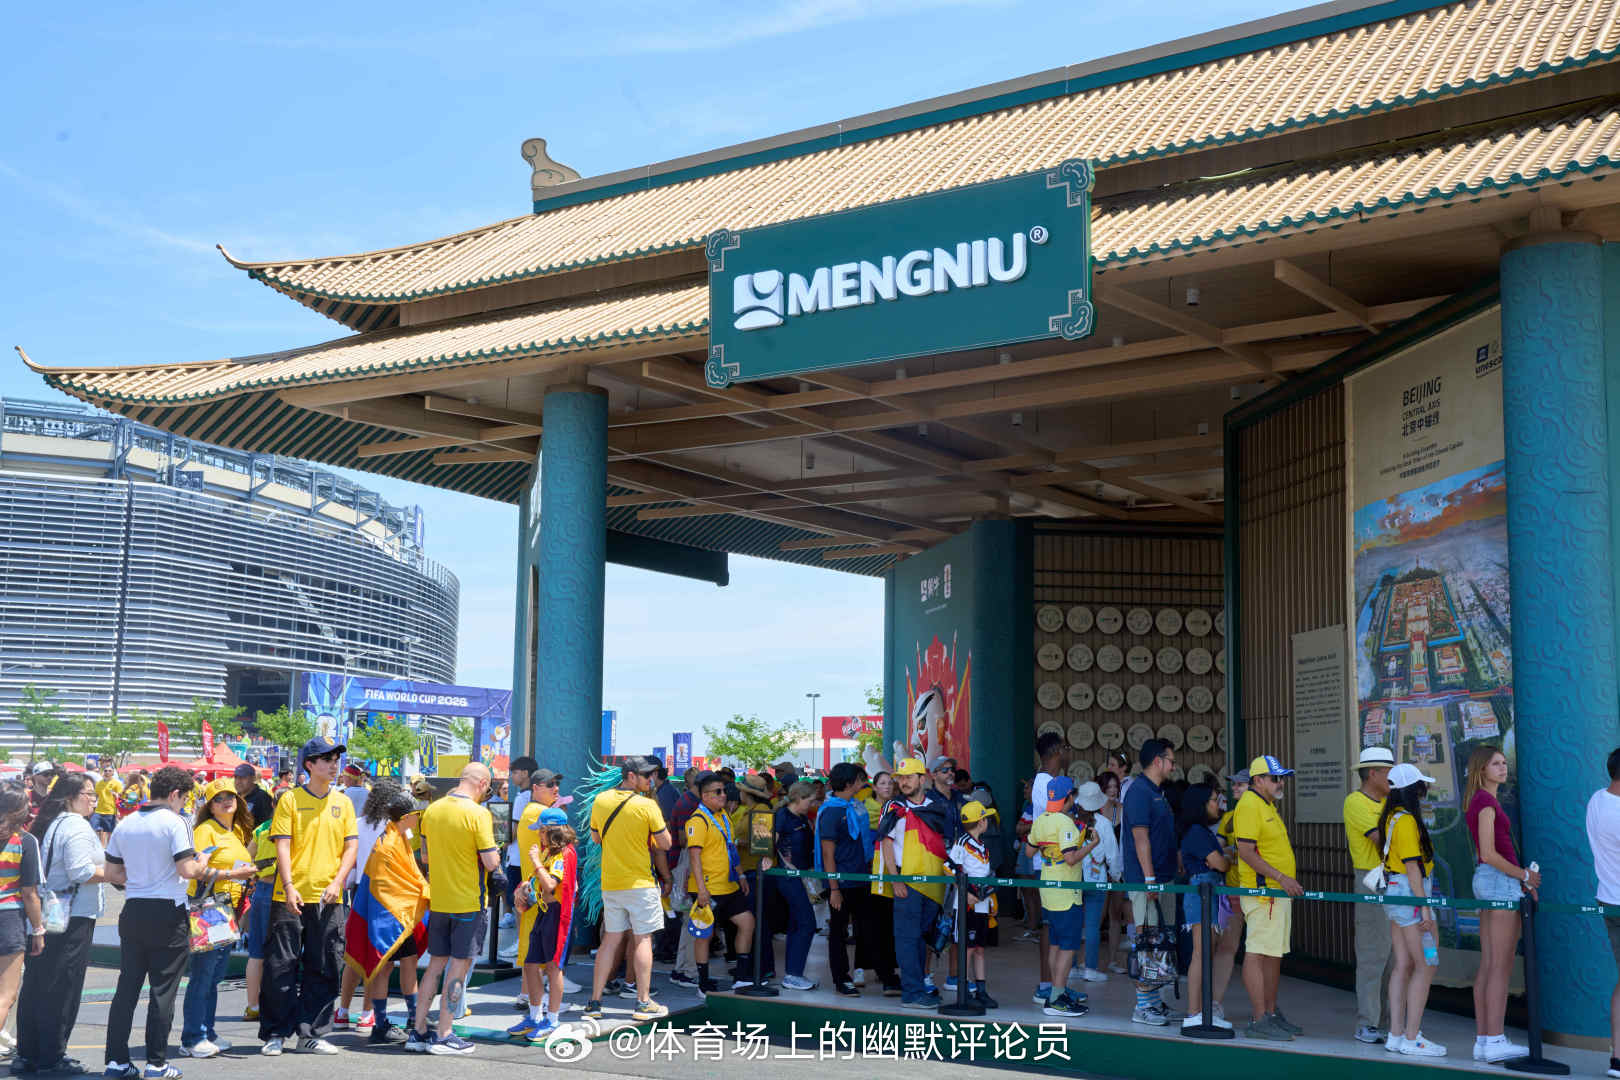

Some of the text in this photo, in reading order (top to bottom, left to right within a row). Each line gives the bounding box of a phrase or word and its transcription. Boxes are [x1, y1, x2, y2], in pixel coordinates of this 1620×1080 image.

[788, 232, 1027, 316] MENGNIU
[1403, 376, 1441, 407] BEIJING
[364, 689, 385, 701] FIFA
[386, 690, 417, 704] WORLD
[419, 692, 436, 705] CUP
